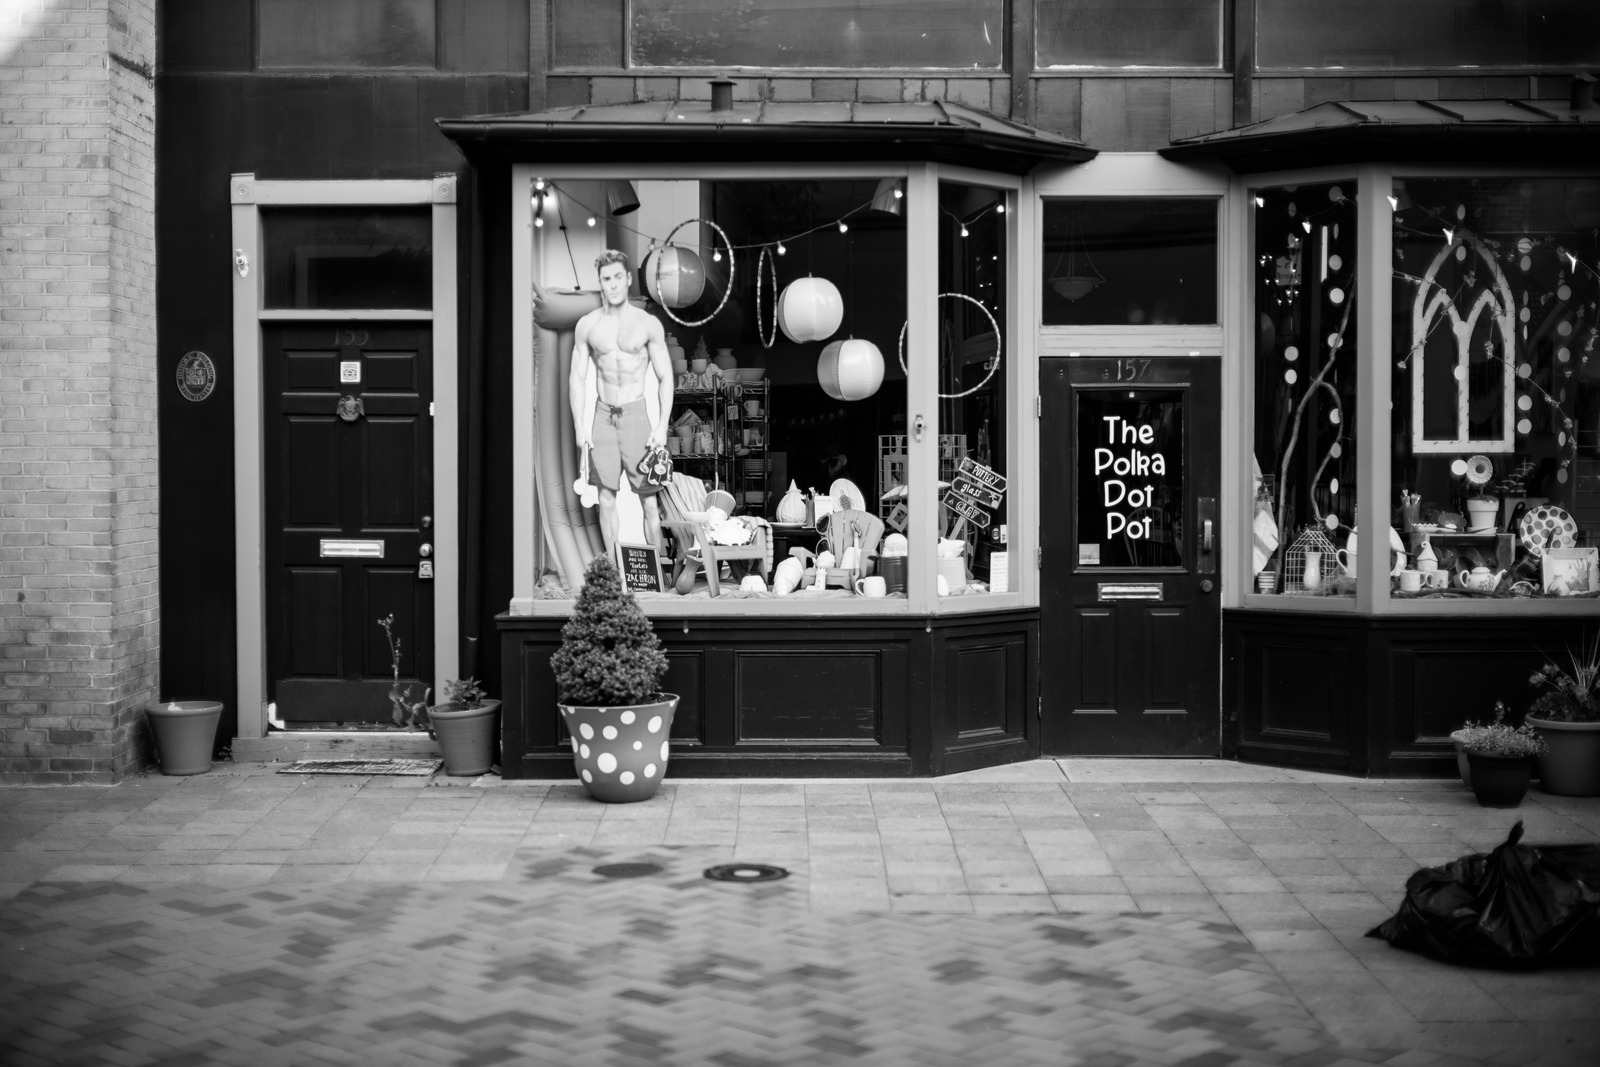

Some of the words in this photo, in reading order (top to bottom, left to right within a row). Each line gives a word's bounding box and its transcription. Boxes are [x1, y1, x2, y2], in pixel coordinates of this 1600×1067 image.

[1117, 359, 1151, 381] 157
[1103, 416, 1154, 444] The
[1094, 448, 1166, 476] Polka
[972, 465, 1000, 486] POTTERY
[961, 483, 982, 497] glass
[1104, 479, 1154, 508] Dot
[955, 501, 980, 519] CLAY
[1107, 512, 1152, 540] Pot
[626, 573, 639, 582] ZAC
